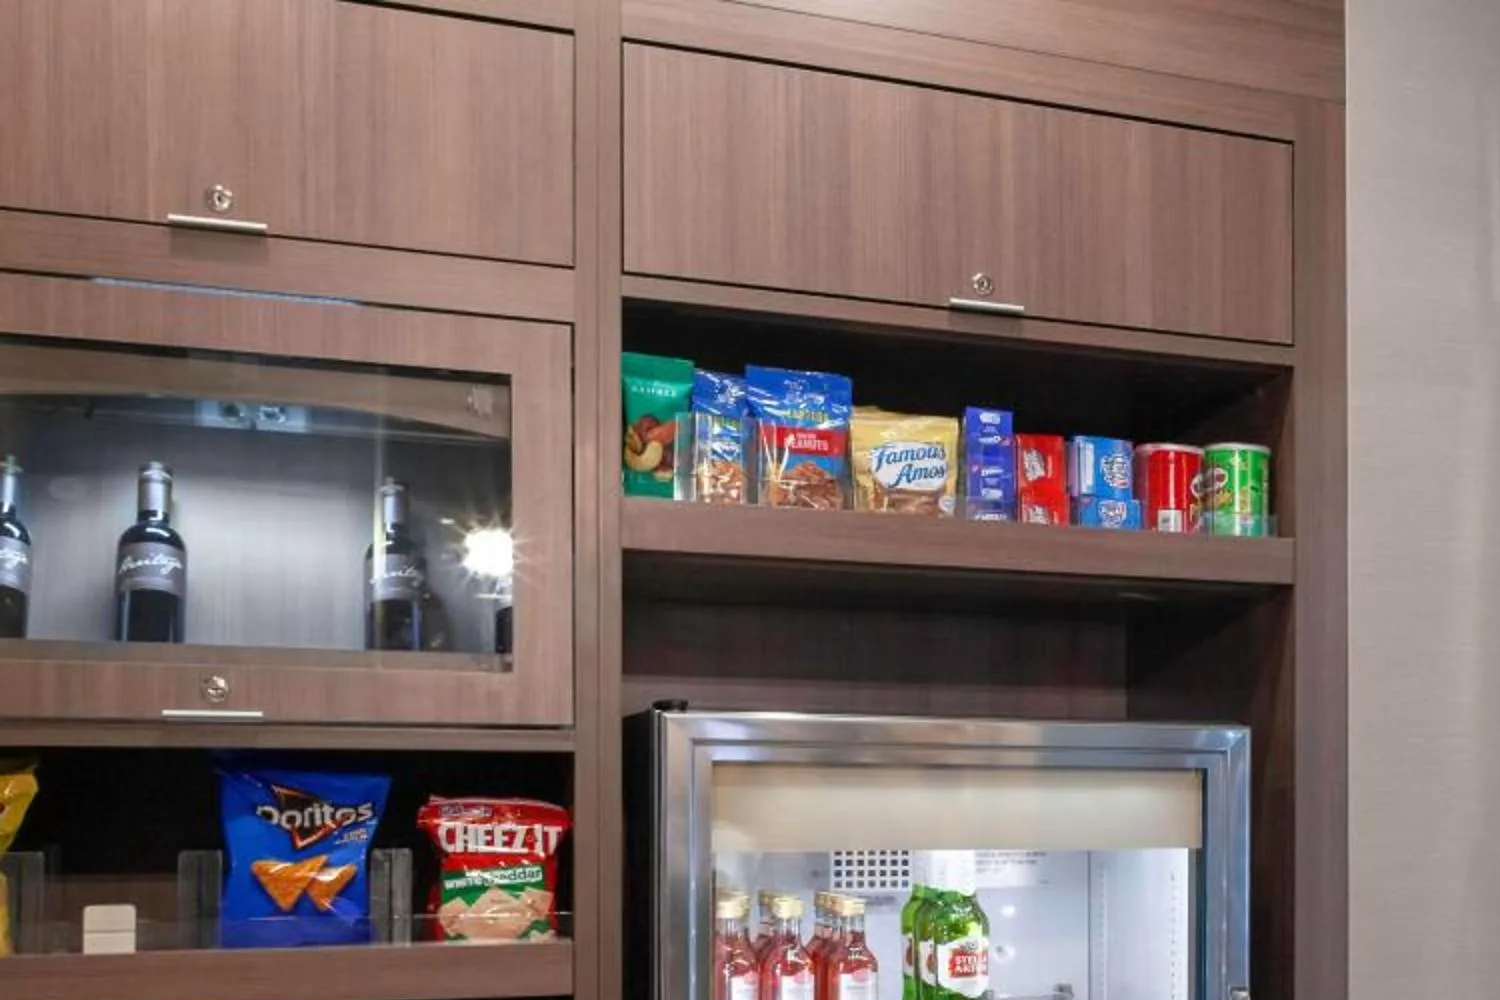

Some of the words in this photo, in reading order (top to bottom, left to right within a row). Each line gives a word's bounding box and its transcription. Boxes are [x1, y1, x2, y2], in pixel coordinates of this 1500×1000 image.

[870, 443, 947, 472] Famous
[887, 461, 946, 489] Amos
[256, 802, 374, 831] Doritos
